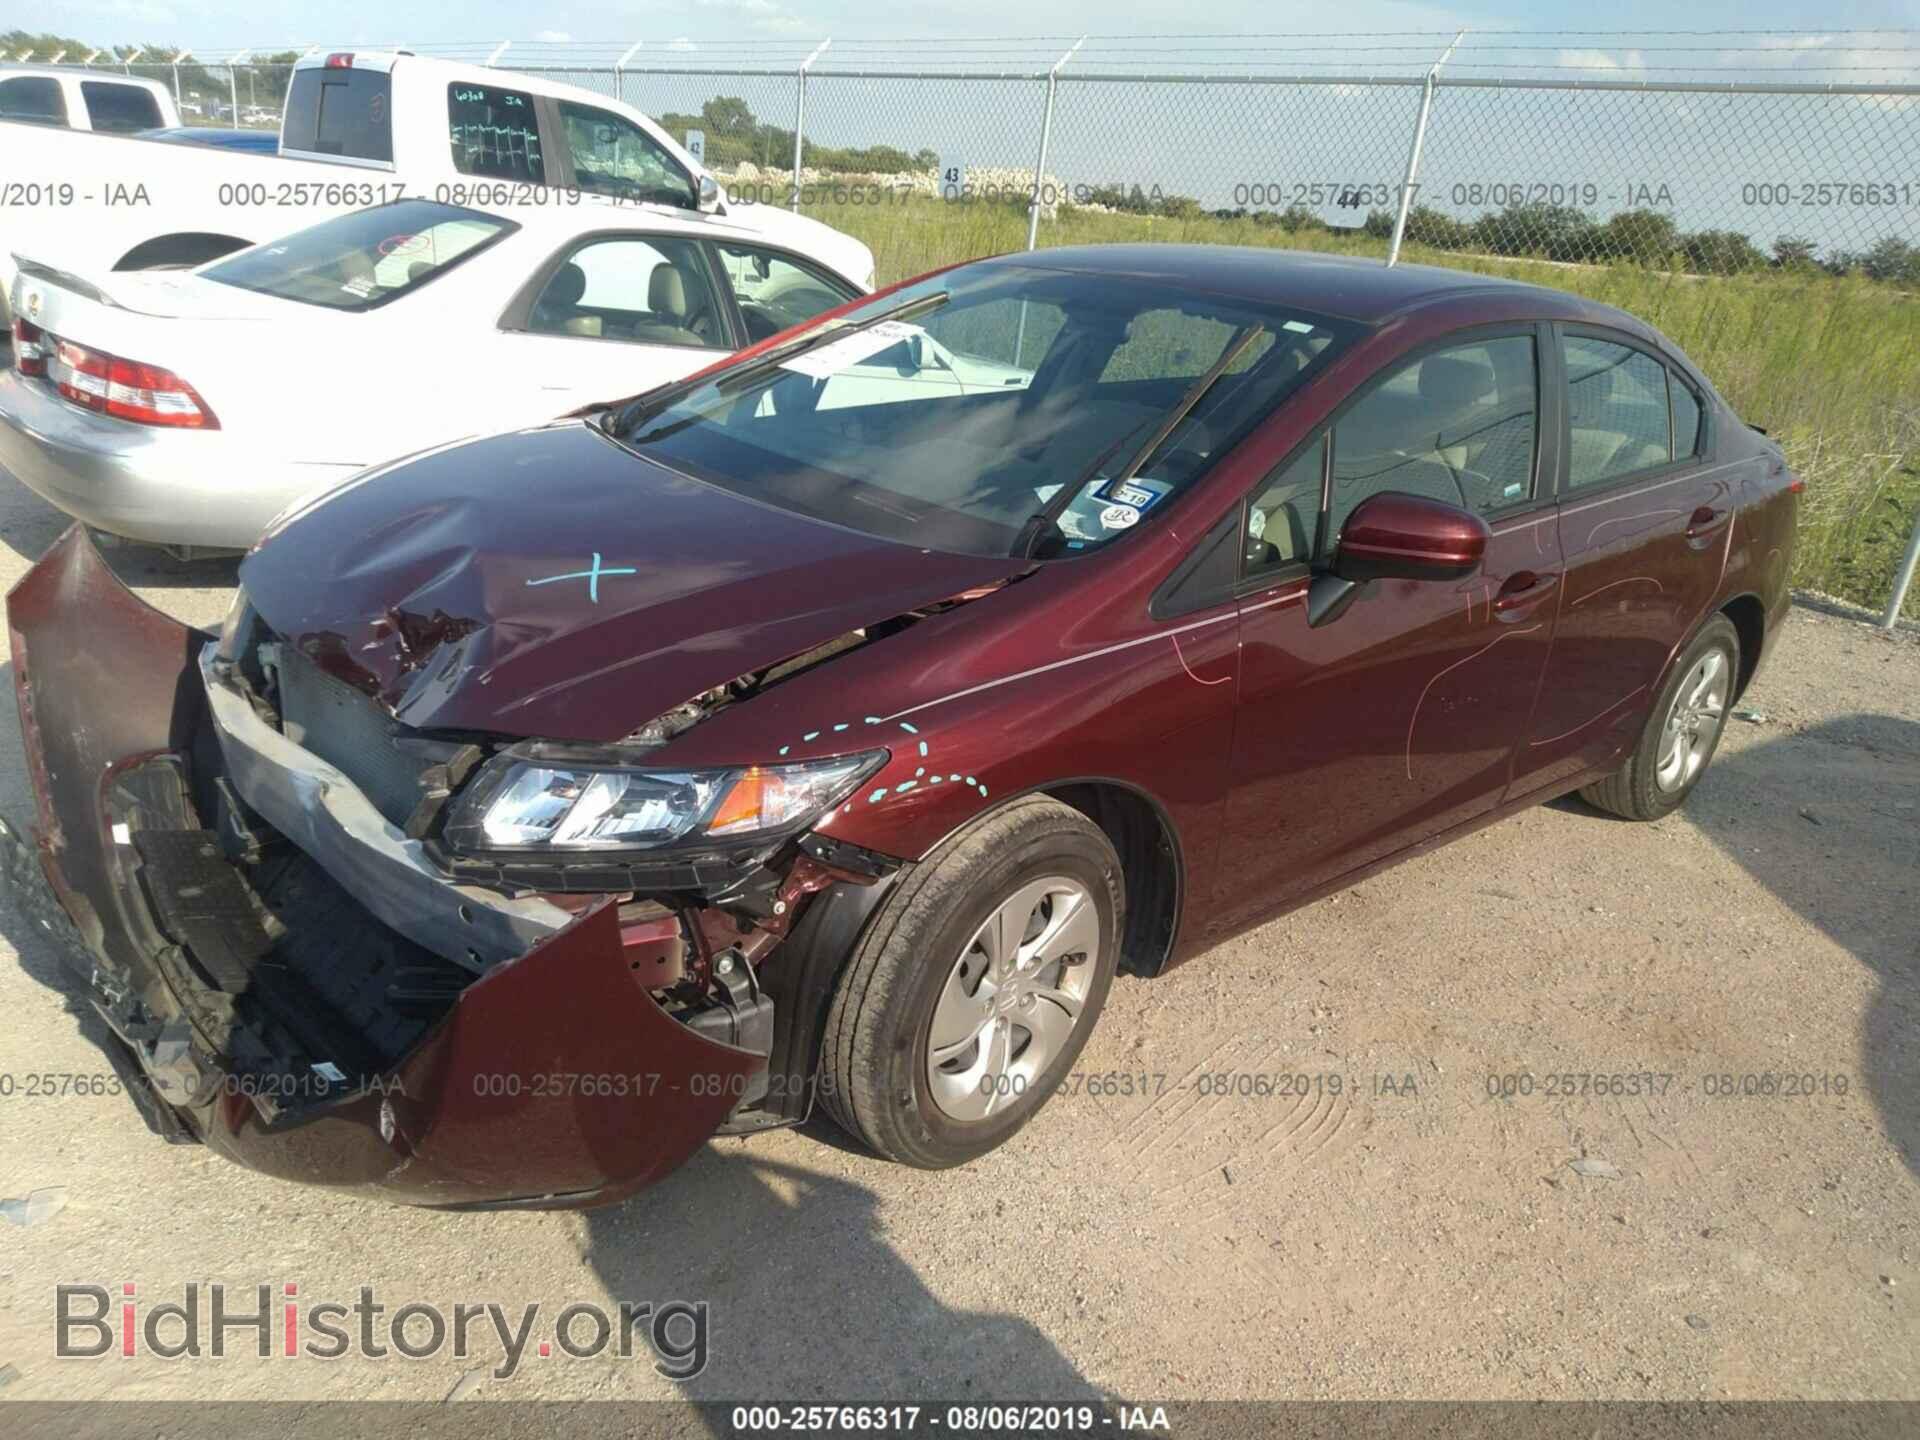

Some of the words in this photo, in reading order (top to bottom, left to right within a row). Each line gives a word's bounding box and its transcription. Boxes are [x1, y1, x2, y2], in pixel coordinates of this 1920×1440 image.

[691, 142, 700, 154] 42
[944, 167, 959, 182] 43
[1337, 191, 1361, 209] 44
